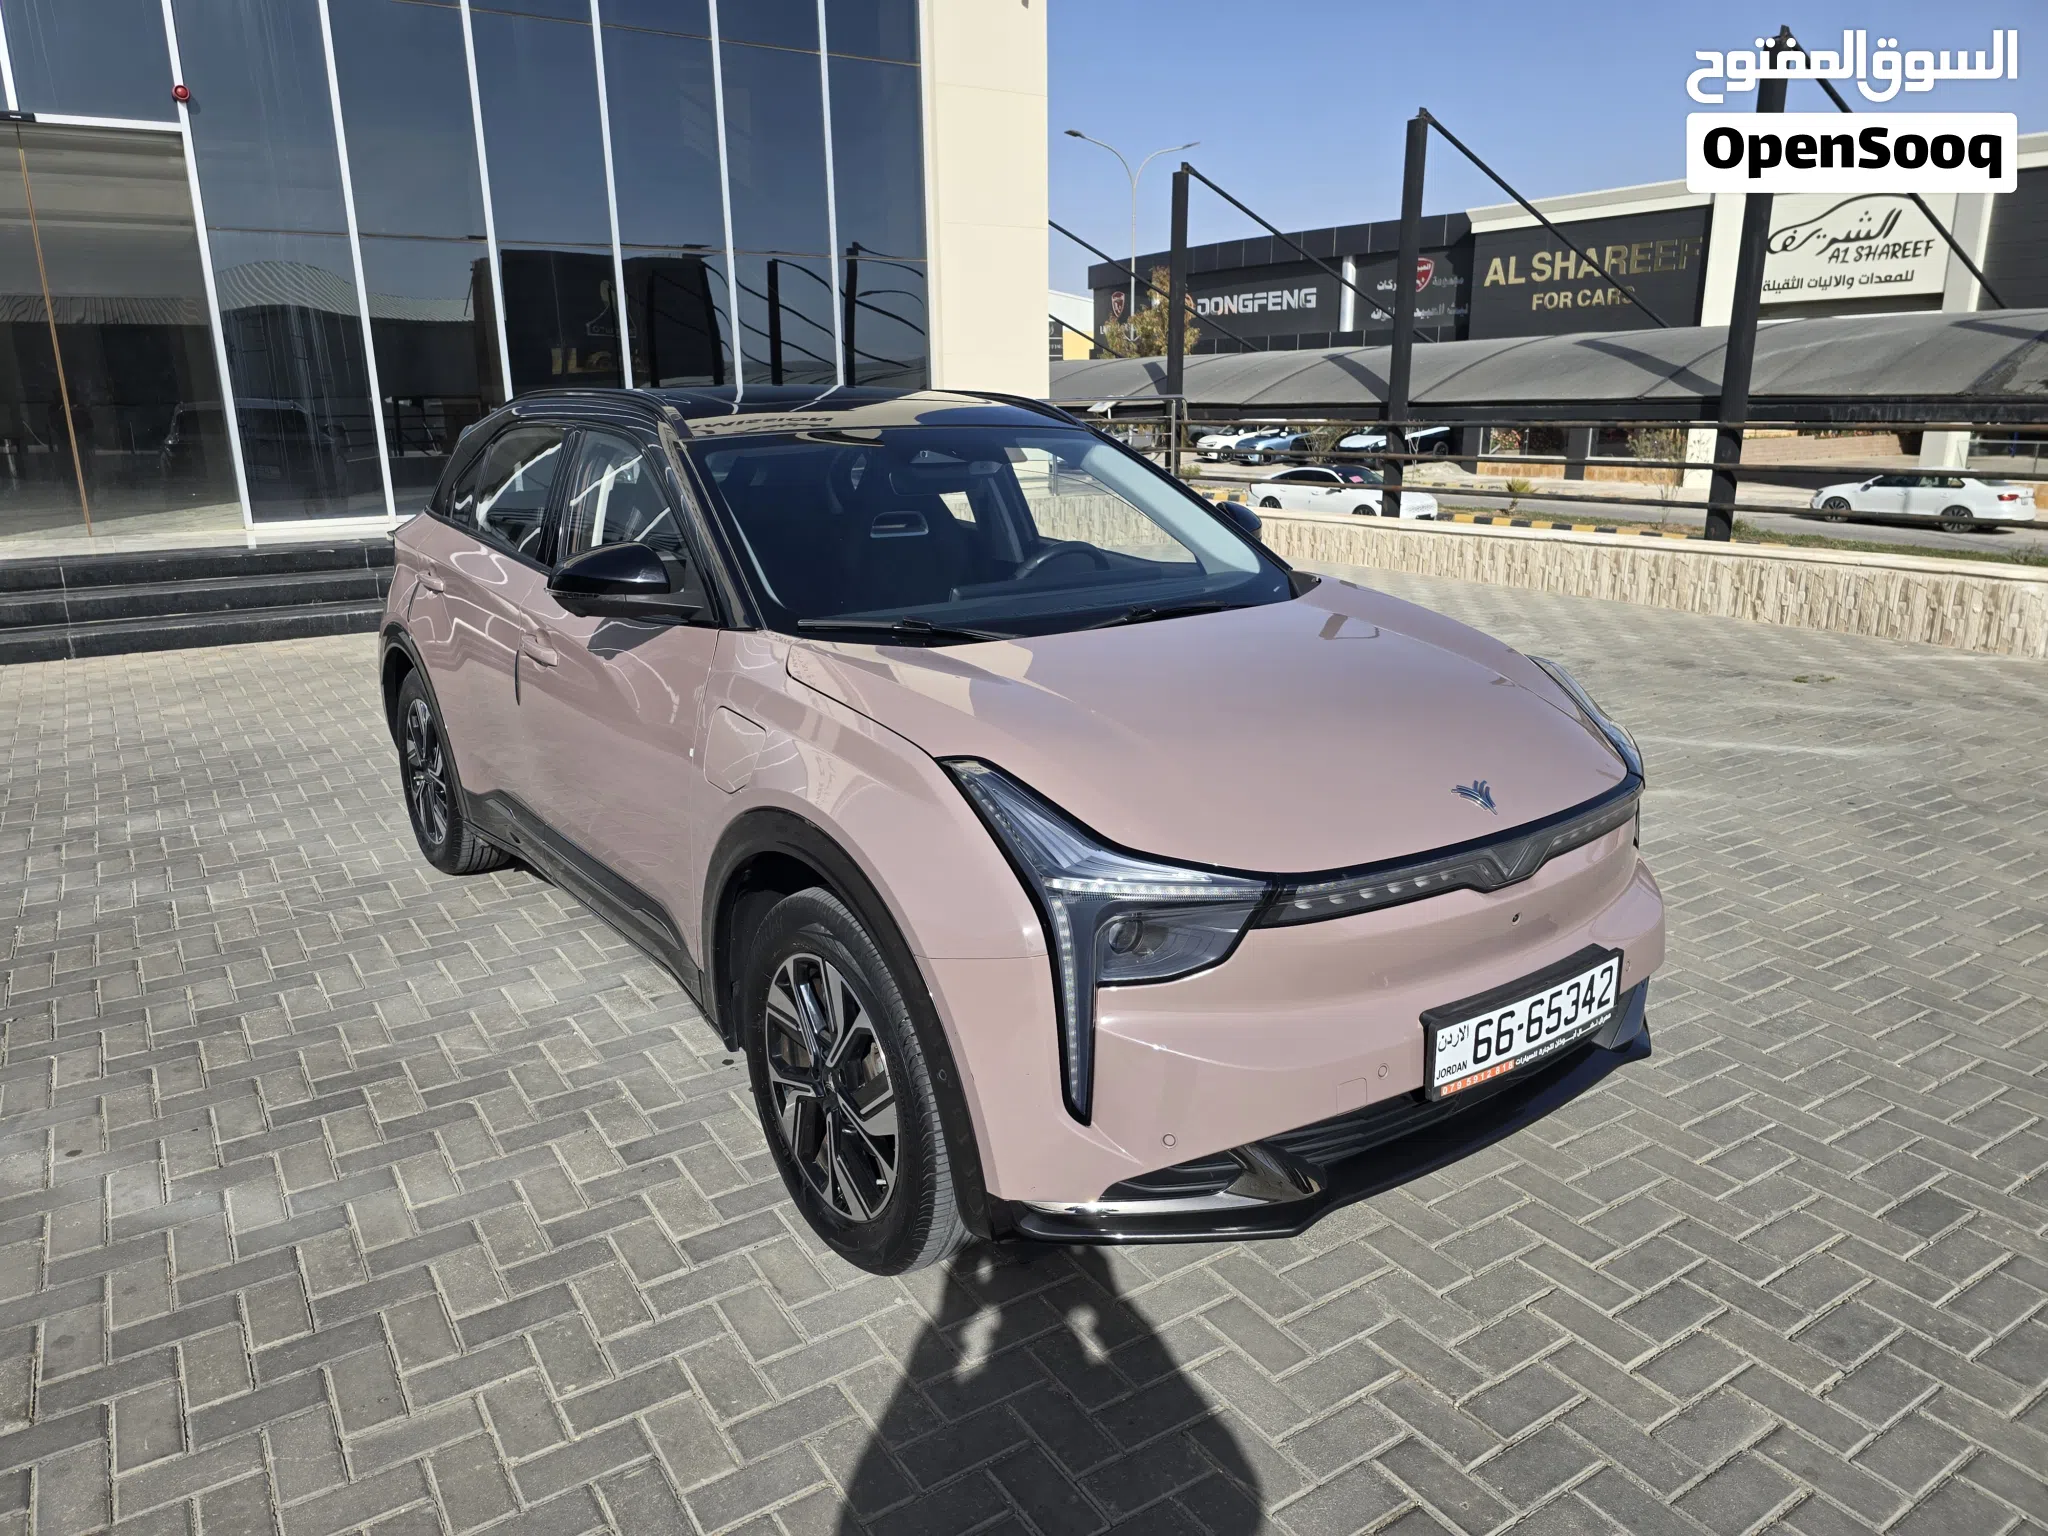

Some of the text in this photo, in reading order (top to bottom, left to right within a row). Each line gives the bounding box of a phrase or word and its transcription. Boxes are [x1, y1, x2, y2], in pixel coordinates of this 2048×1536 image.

[1767, 207, 1903, 256] الشريف
[1484, 236, 1703, 287] AL SHAREEF
[1828, 238, 1936, 265] AL SHAREEF
[1762, 275, 1804, 294] الثقيلة
[1858, 269, 1915, 285] للمعدات
[1196, 287, 1318, 318] DONGFENG
[1531, 285, 1636, 311] FOR CARS
[1436, 1060, 1468, 1080] JORDAN
